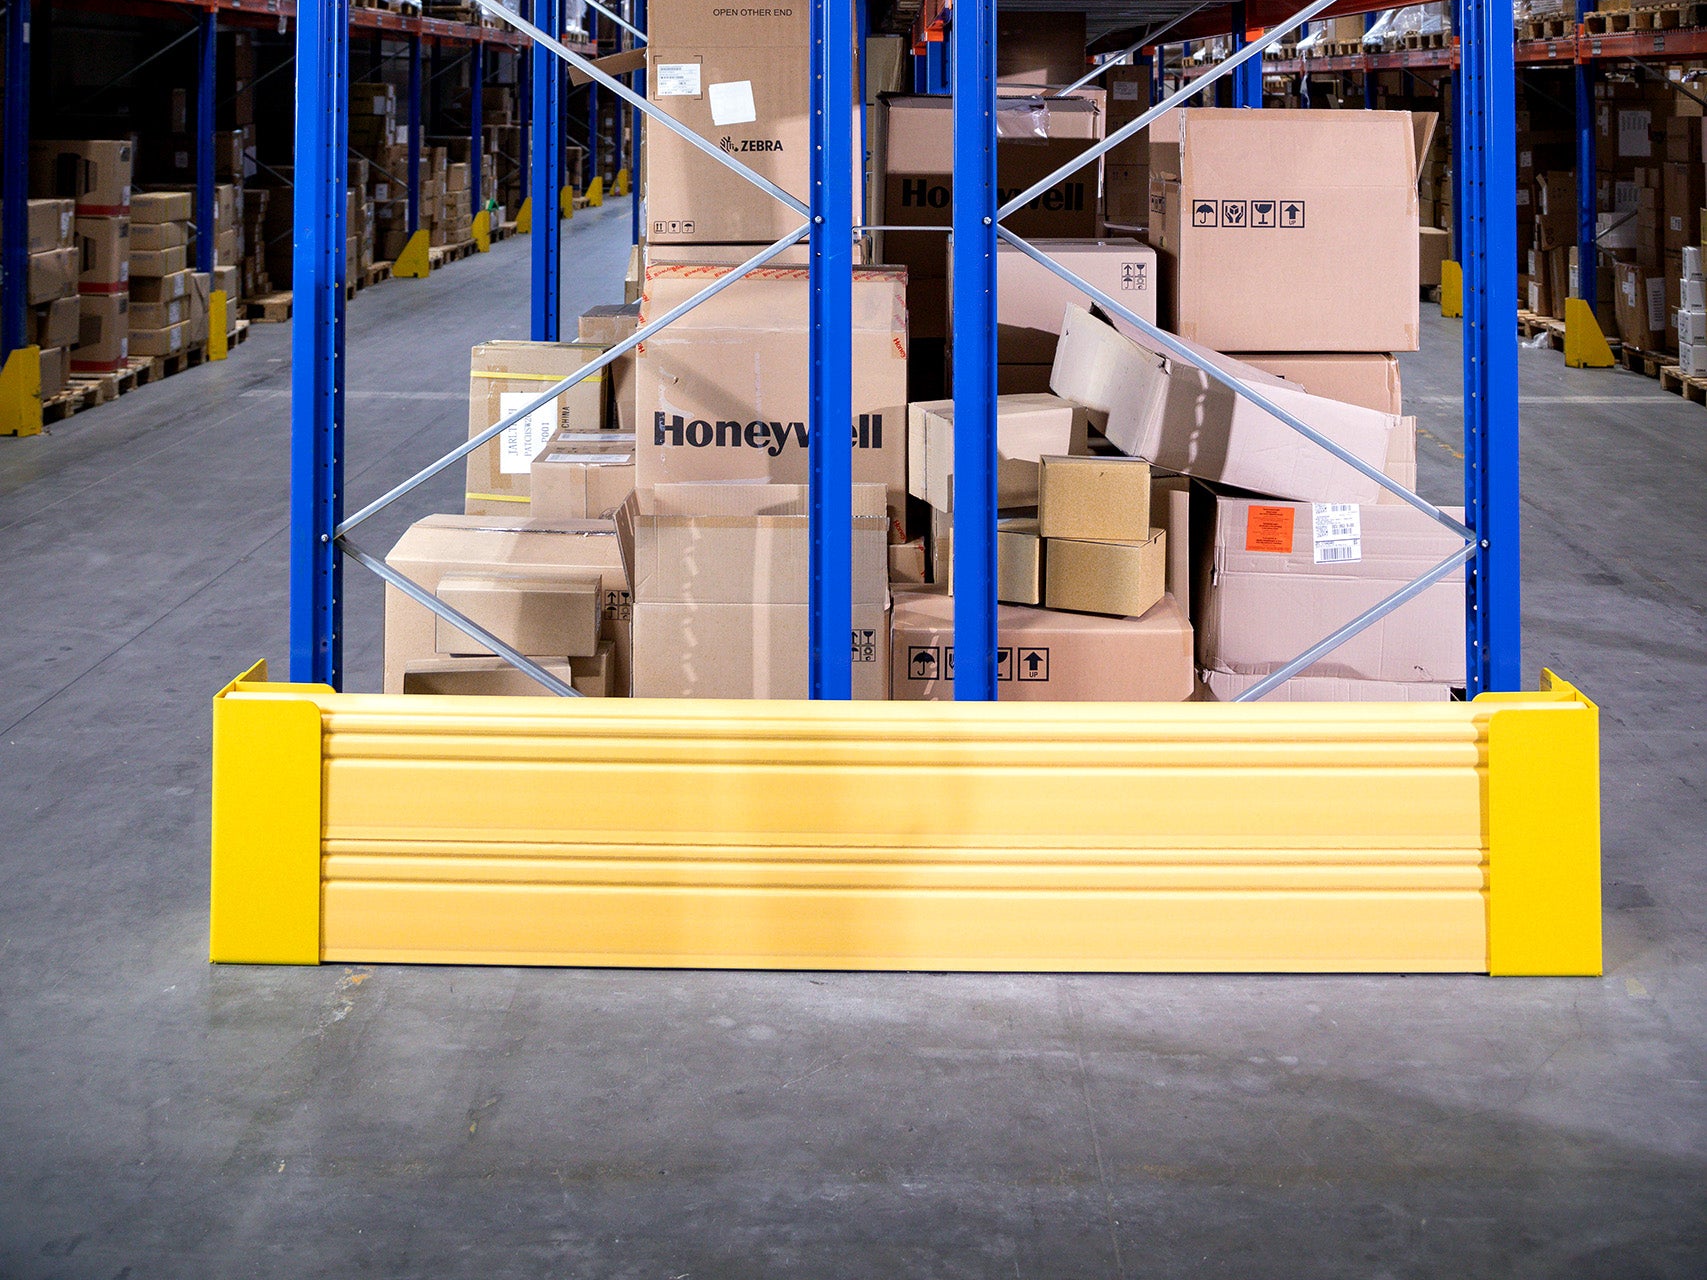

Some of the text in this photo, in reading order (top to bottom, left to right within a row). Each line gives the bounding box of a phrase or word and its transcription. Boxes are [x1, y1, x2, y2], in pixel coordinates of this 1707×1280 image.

[713, 8, 793, 17] OPEN OTHER END
[741, 140, 784, 152] ZEBRA
[561, 406, 570, 429] CHINA
